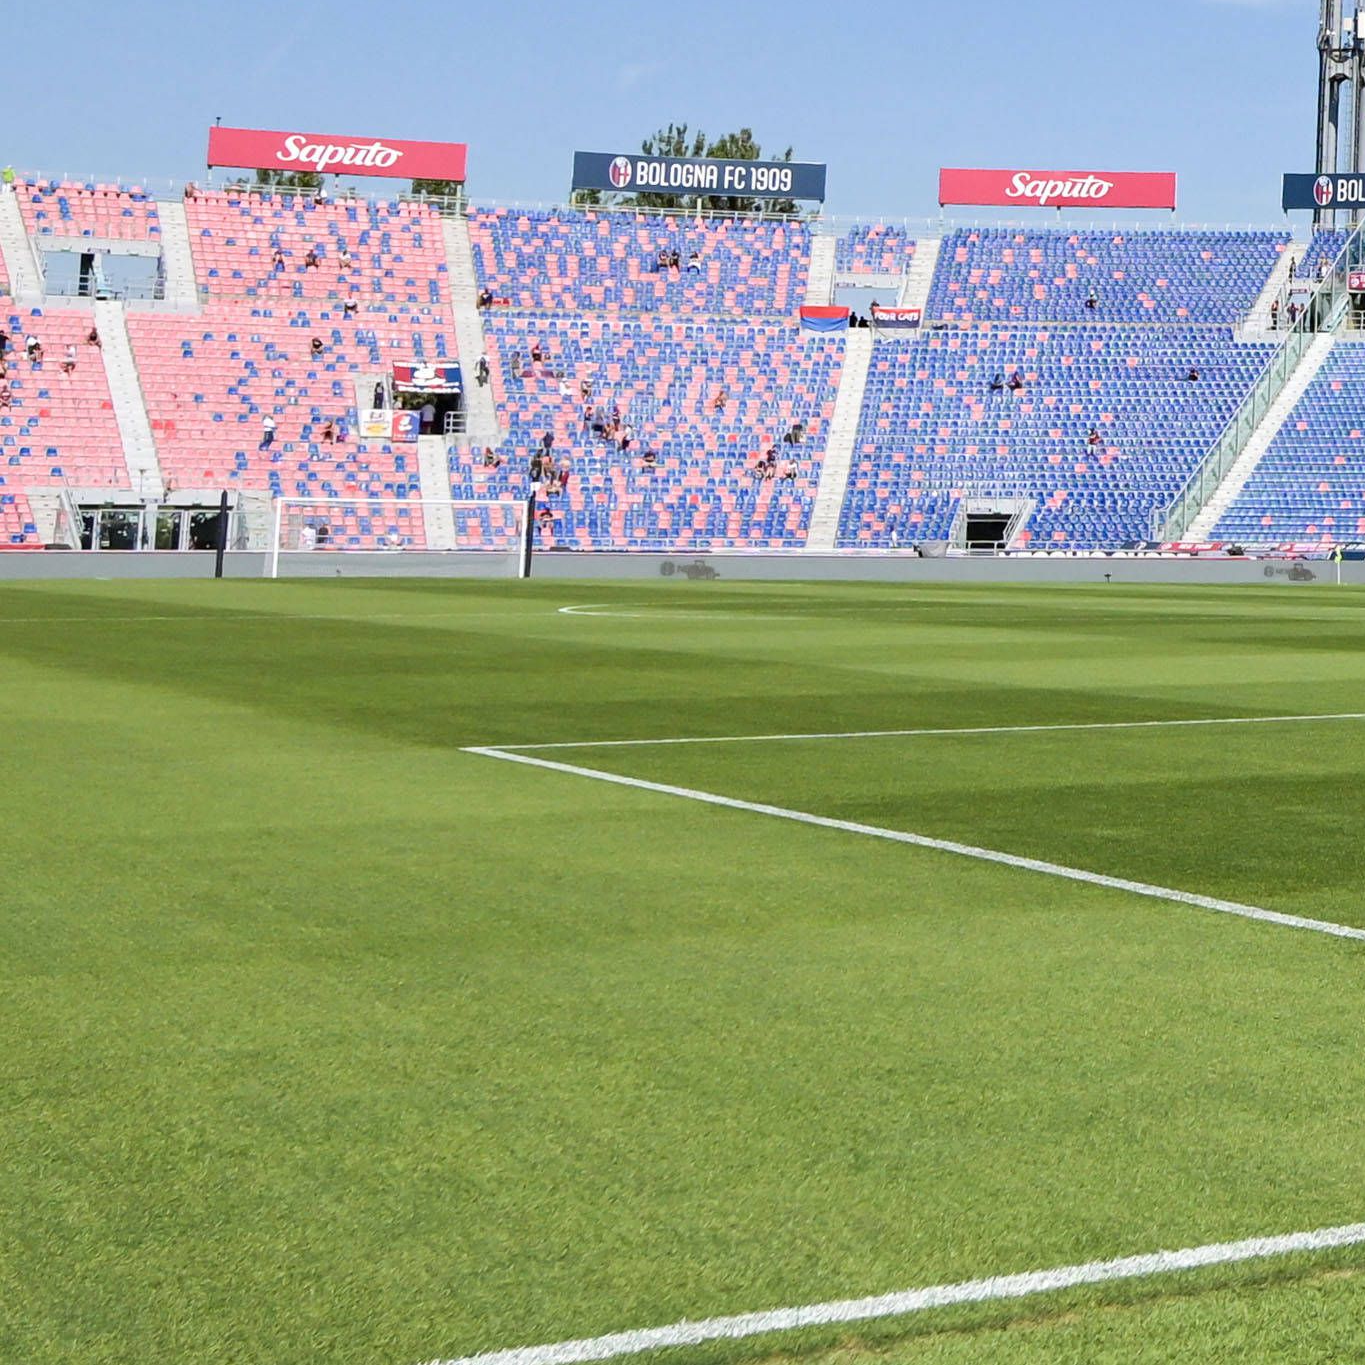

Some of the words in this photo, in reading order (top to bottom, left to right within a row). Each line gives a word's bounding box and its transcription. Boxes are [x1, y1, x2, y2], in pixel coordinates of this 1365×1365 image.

[276, 135, 404, 171] Saputo
[636, 161, 717, 189] BOLOGNA
[724, 166, 746, 190] FC
[750, 167, 792, 192] 1909
[1005, 172, 1113, 205] Saputo
